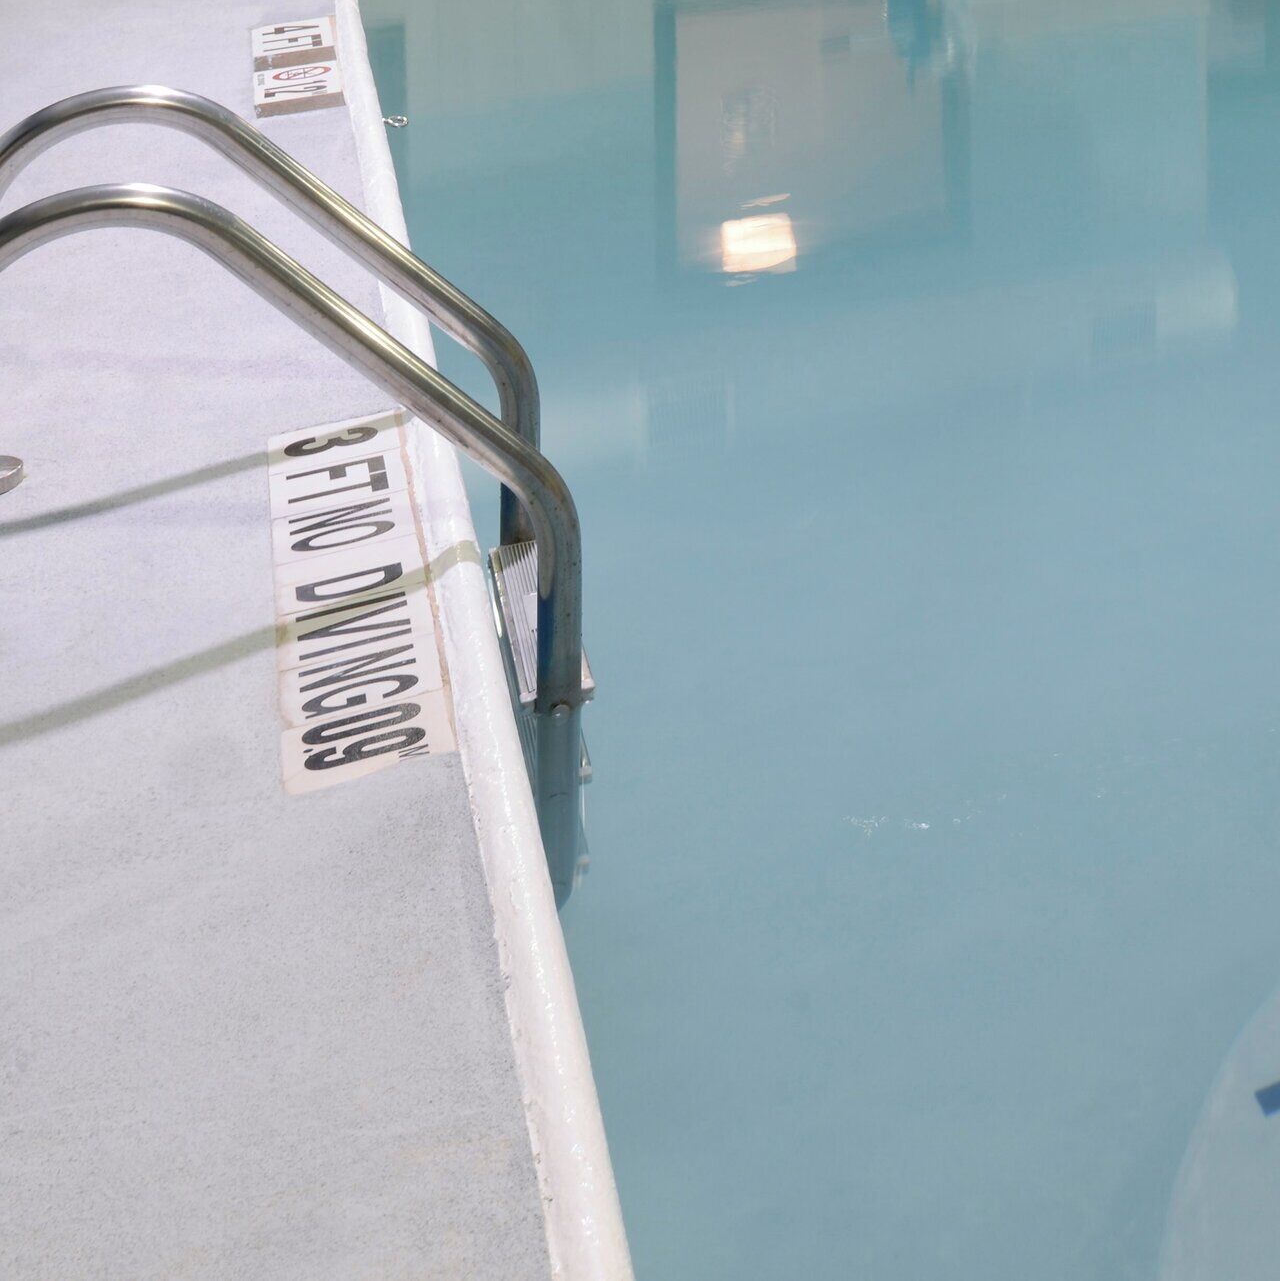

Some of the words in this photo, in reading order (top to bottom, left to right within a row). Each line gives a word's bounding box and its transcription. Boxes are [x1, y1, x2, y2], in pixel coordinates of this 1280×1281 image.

[262, 25, 319, 36] 4
[262, 34, 323, 52] FT
[284, 426, 379, 457] 3
[286, 455, 390, 504] FT
[288, 497, 396, 552] NO
[295, 562, 419, 719] DIVING
